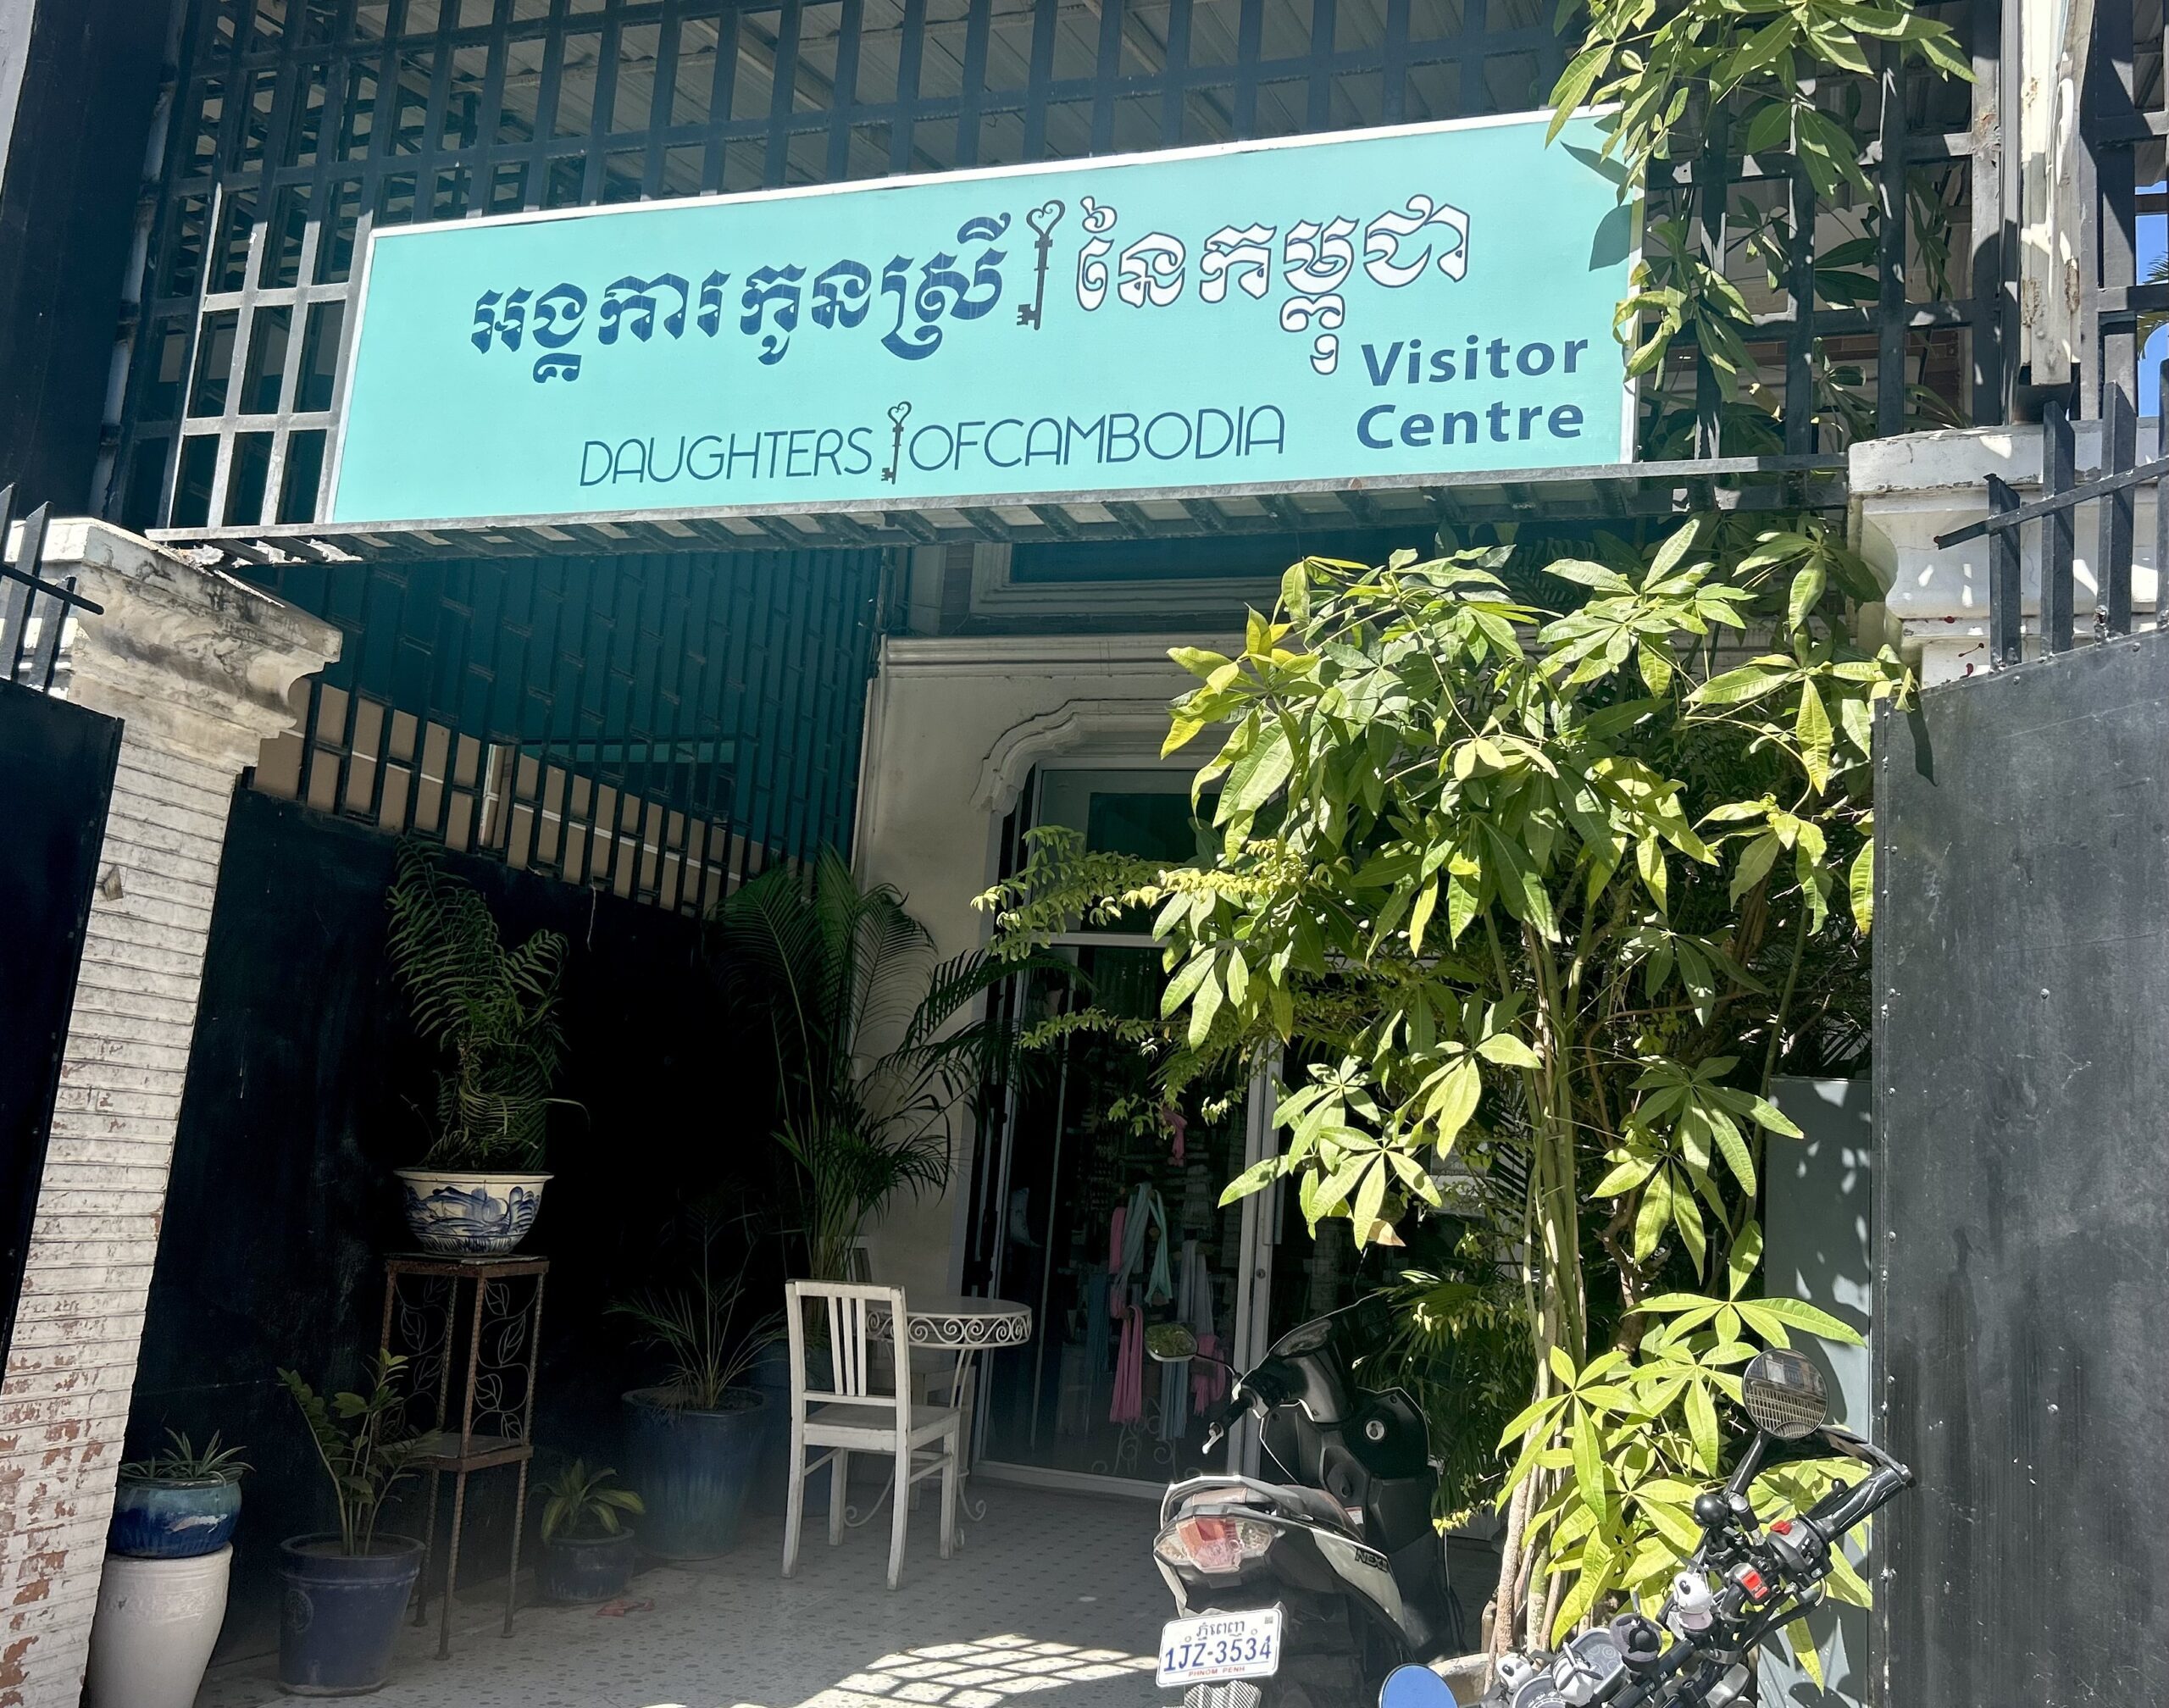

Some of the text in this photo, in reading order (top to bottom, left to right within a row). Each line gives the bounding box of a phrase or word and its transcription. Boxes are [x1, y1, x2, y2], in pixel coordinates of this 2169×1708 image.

[1361, 334, 1589, 386] Visitor
[1356, 400, 1584, 450] Centre
[580, 426, 874, 487] DAUGHTERS
[1164, 1635, 1271, 1672] 1JZ-3534
[1188, 1667, 1218, 1677] PHNOM
